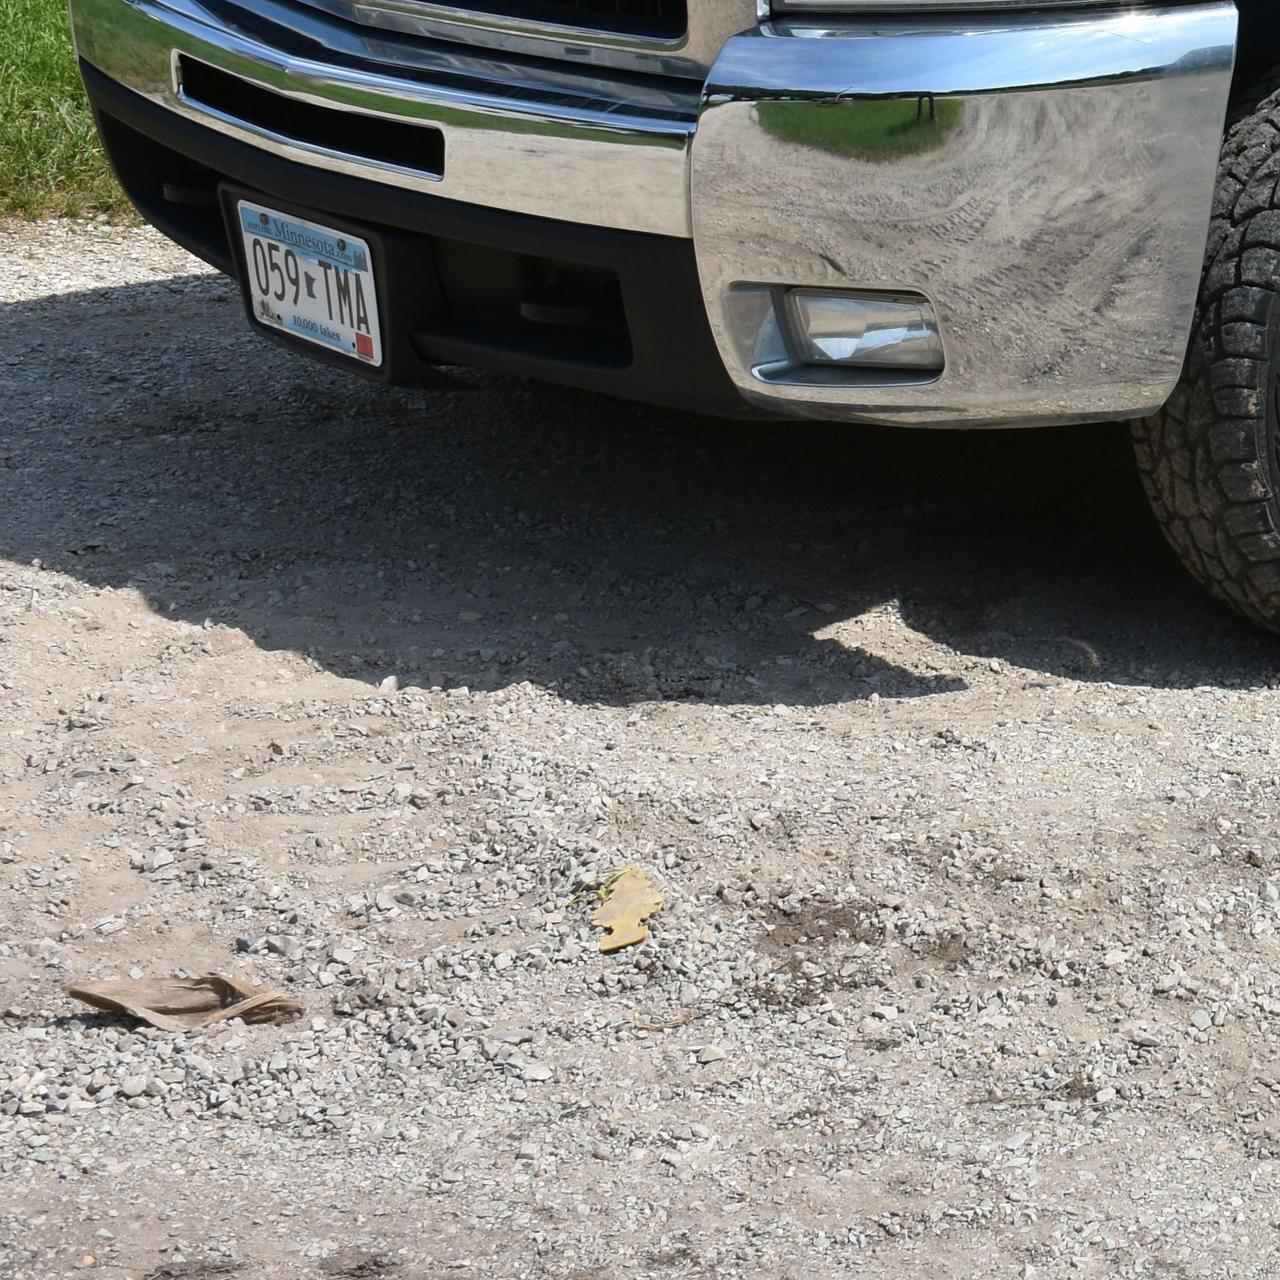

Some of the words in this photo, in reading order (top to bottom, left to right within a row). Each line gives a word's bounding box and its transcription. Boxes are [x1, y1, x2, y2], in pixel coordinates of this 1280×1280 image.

[273, 221, 334, 255] Minnesota
[253, 238, 300, 307] 059
[318, 260, 371, 335] TMA
[319, 324, 341, 342] lakes
